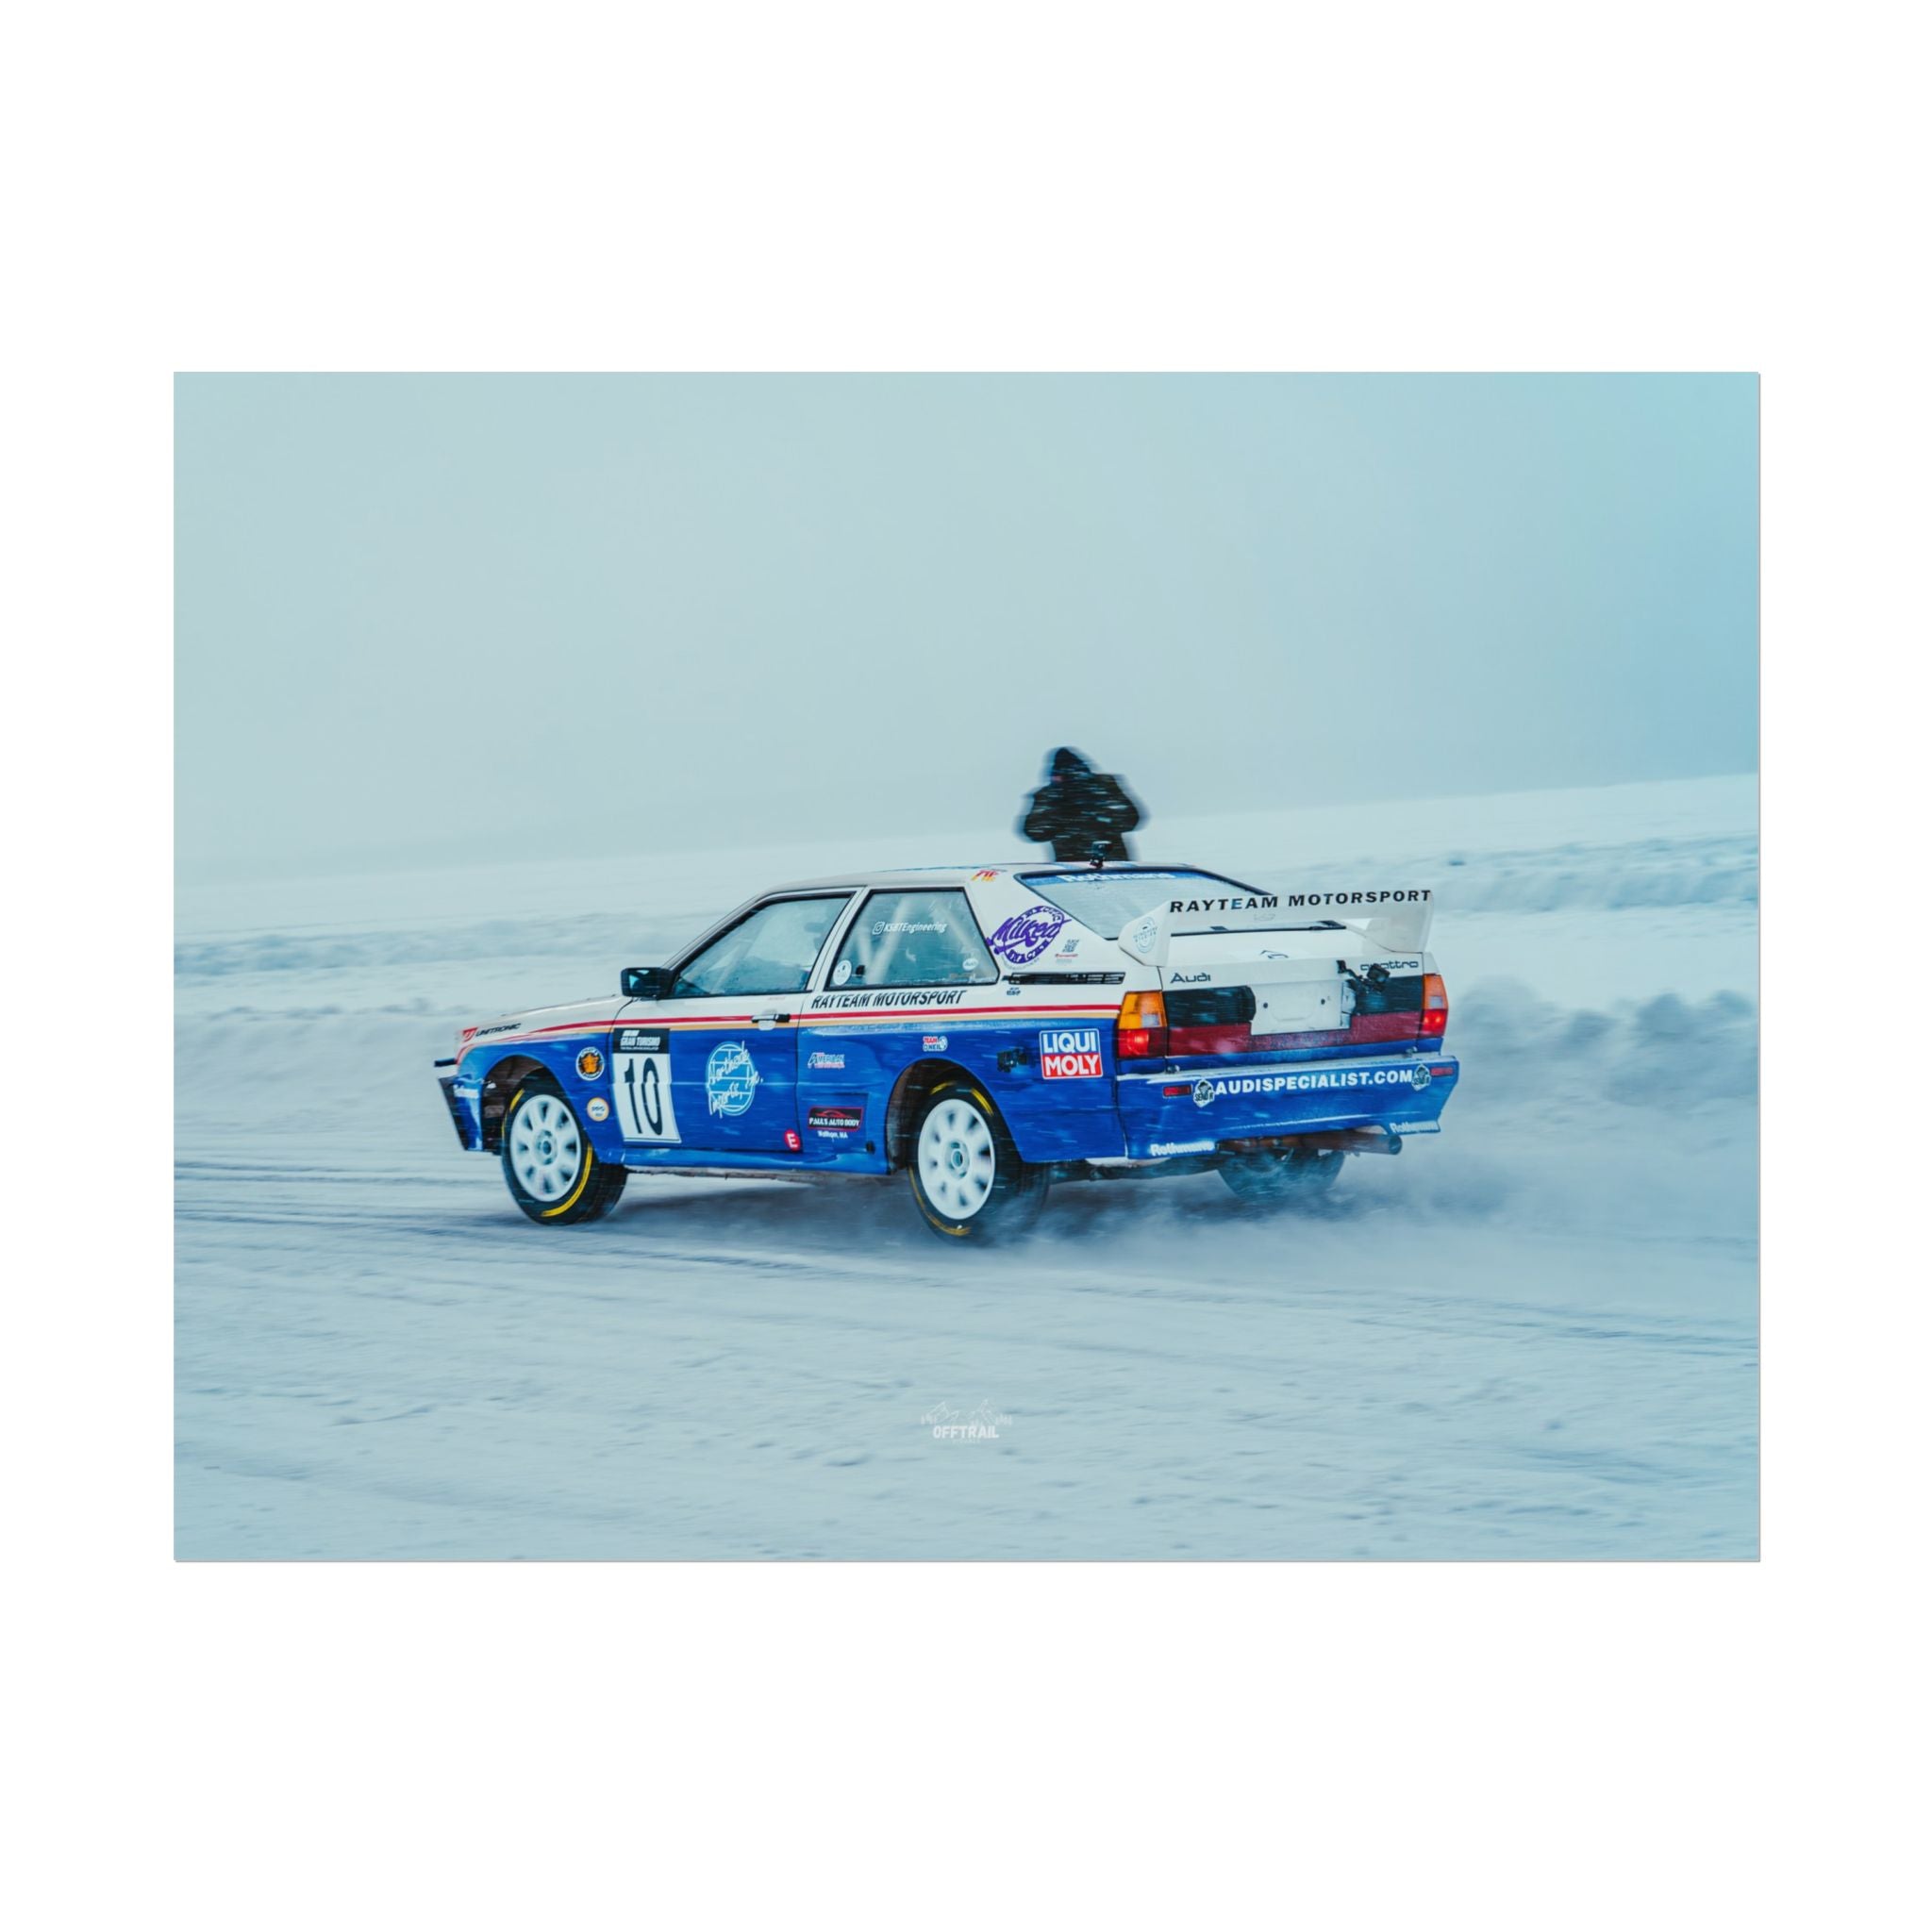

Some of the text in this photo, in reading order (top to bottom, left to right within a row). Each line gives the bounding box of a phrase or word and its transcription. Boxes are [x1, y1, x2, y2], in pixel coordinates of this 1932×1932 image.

[1170, 890, 1432, 913] RAYTEAM MOTORSPORT
[1170, 972, 1211, 984] Audi
[811, 990, 968, 1009] RAYTEAM MOTORSPORT
[1042, 1031, 1097, 1054] LIQUI
[1044, 1054, 1100, 1076] MOLY
[1215, 1069, 1413, 1095] AUDISPECIALIST.COM
[624, 1058, 663, 1136] 10
[786, 1132, 799, 1149] E
